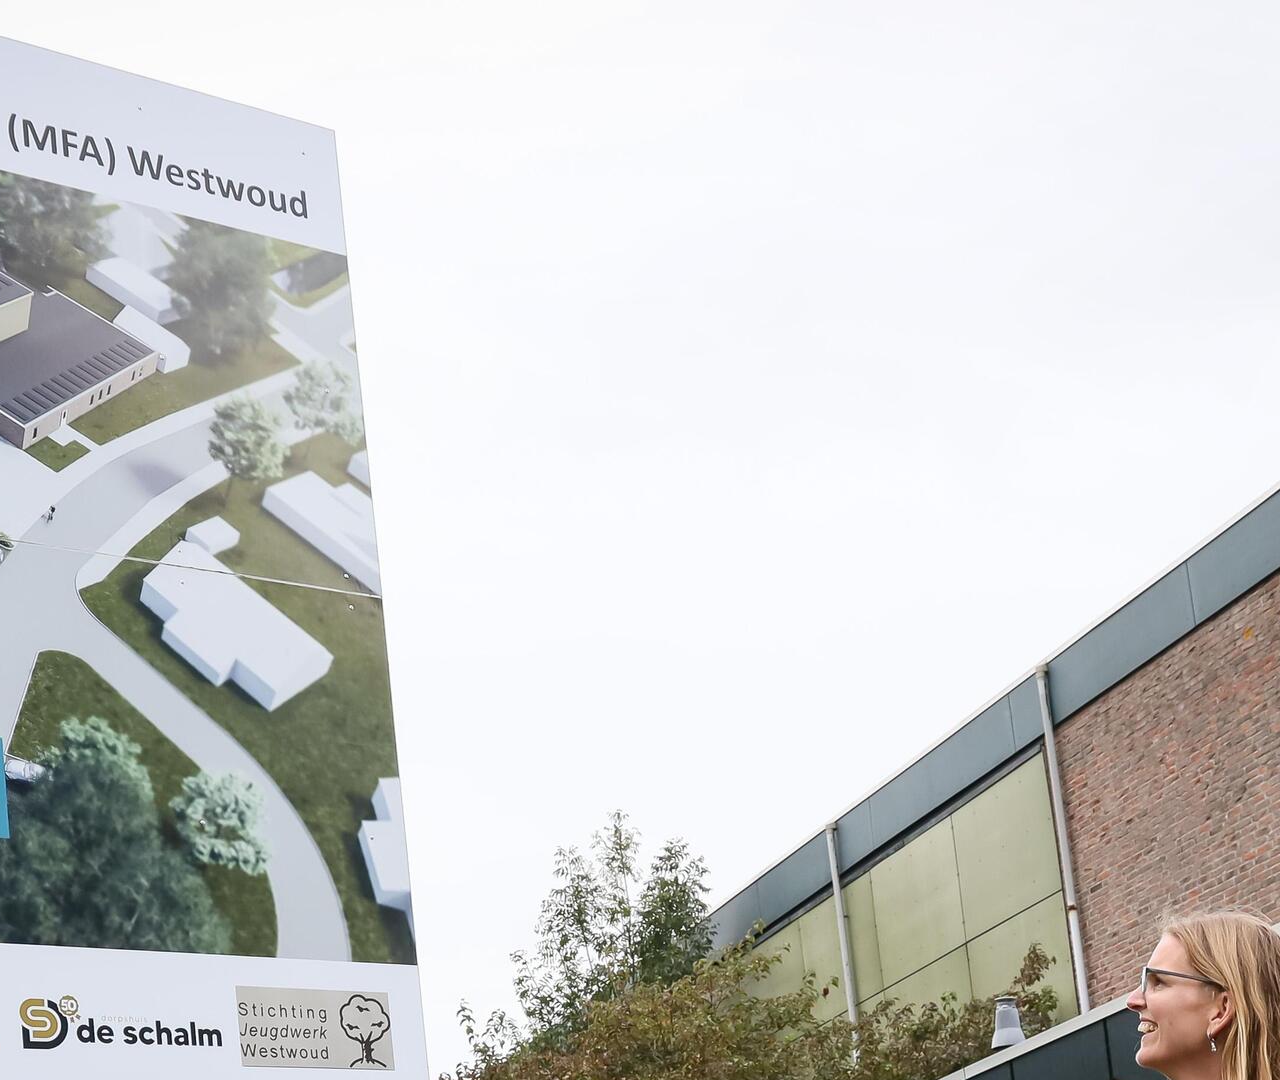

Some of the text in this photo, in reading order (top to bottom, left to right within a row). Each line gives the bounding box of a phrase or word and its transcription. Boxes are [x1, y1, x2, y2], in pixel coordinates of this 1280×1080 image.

[8, 113, 116, 176] (MFA)
[126, 145, 309, 219] Westwoud
[238, 1002, 328, 1023] Stichting
[76, 1017, 223, 1047] de schalm
[239, 1023, 328, 1041] Jeugdwerk
[240, 1043, 330, 1060] Westwoud
